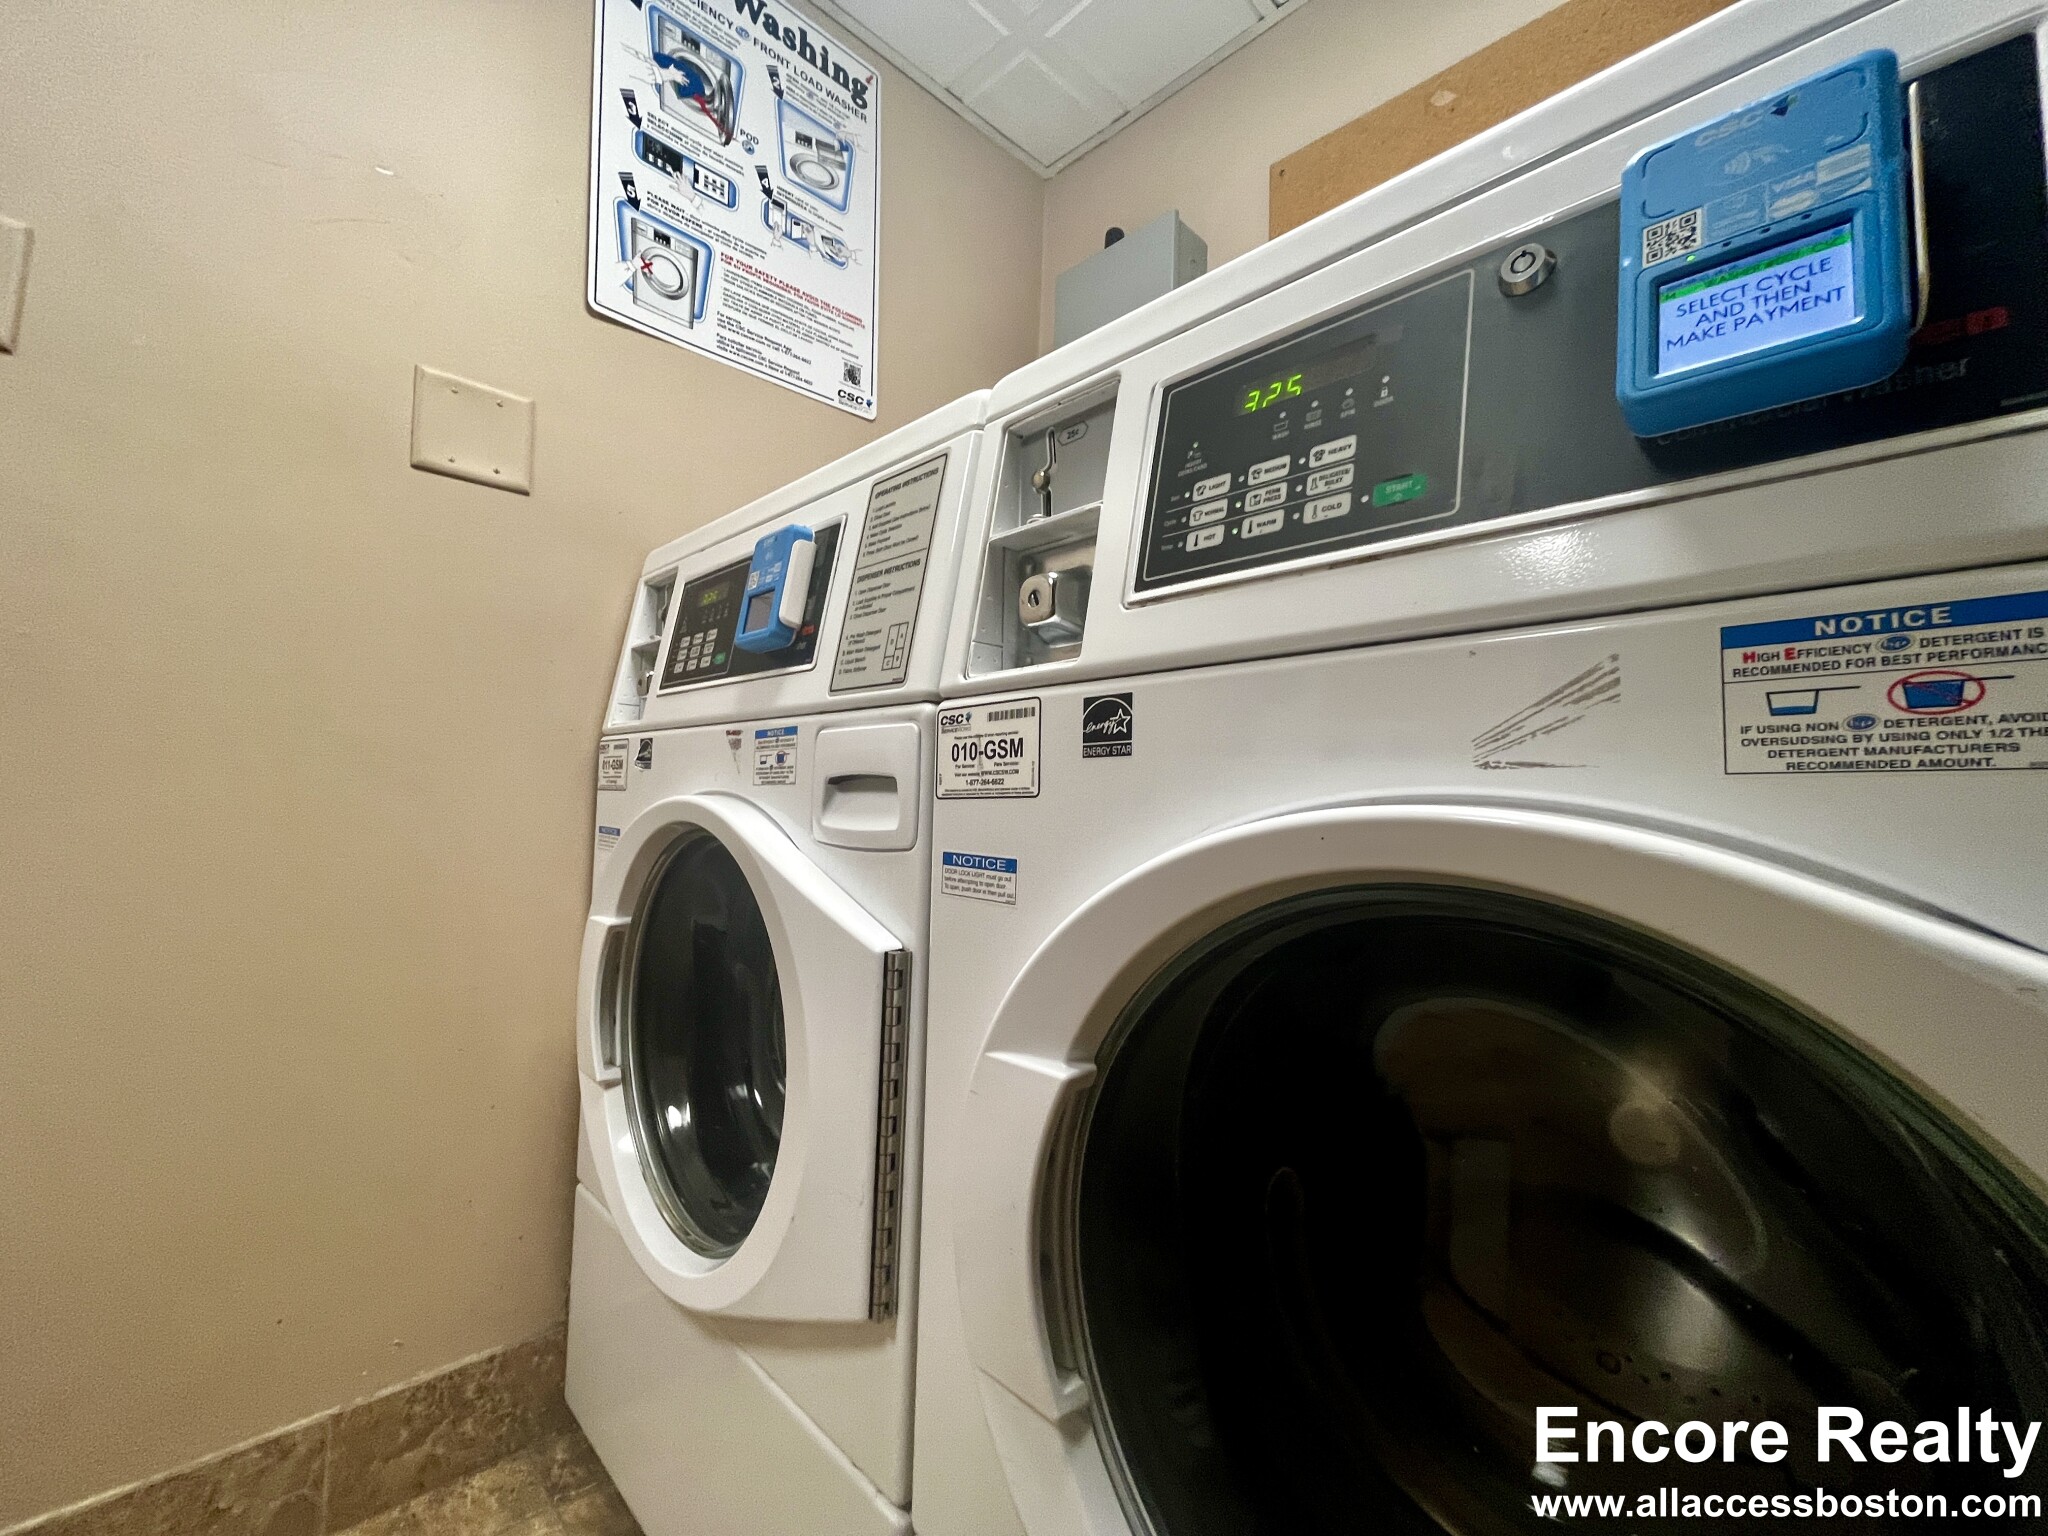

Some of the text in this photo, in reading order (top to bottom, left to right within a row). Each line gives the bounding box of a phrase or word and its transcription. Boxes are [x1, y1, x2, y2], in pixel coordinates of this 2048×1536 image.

[733, 0, 869, 110] Washing
[753, 37, 791, 69] FRONT
[794, 65, 822, 91] LOAD
[825, 87, 868, 123] WASHER
[772, 76, 780, 89] 2
[628, 102, 637, 115] 3
[740, 128, 759, 145] POD
[761, 178, 769, 188] 4
[626, 184, 636, 198] 5
[721, 251, 734, 260] FOR
[736, 258, 753, 270] YOUR
[755, 267, 777, 282] SAFETY
[779, 279, 800, 294] PLEASE
[802, 290, 819, 303] AVOID
[820, 299, 830, 308] THE
[1677, 283, 1749, 317] SELECT
[1756, 257, 1832, 291] CYCLE
[1695, 280, 1811, 327] AND THEN
[1667, 286, 1846, 350] MAKE PAYMENT
[838, 389, 864, 405] CSC
[1328, 443, 1352, 455] HEAVY
[1264, 463, 1287, 474] MEDIUM
[1209, 481, 1226, 490] LIGHT
[1265, 487, 1280, 496] PERM
[1386, 480, 1413, 494] START
[1263, 494, 1281, 503] PRESS
[1205, 506, 1224, 516] NORMAL
[1322, 502, 1342, 512] COLD
[1257, 519, 1276, 527] WARM
[1204, 533, 1216, 541] HOT
[884, 558, 921, 575] INSTRUCTIONS
[1814, 605, 1953, 637] NOTICE
[1742, 627, 2044, 664] HIGH EFFICIENCY DETERGENT IS
[1733, 660, 1841, 678] RECOMMENDED
[1845, 657, 1876, 669] FOR
[1881, 652, 1922, 667] BEST
[940, 714, 964, 726] CSC
[1740, 725, 1753, 735] IF
[1756, 723, 1801, 734] USING
[1806, 722, 1839, 732] NON
[1883, 714, 1993, 729] DETERGENT,
[1741, 726, 2048, 747] OVERSUDSING BY USING ONLY 1/2 THE
[951, 737, 1024, 762] 010-GSM
[1083, 745, 1132, 757] ENERGY STAR
[1768, 742, 2020, 759] DETERGENT MANUFACTURERS
[1786, 757, 1997, 771] RECOMMENDED AMOUNT.
[952, 855, 1007, 870] NOTICE
[972, 871, 985, 879] LIGHT
[958, 878, 978, 887] attempting
